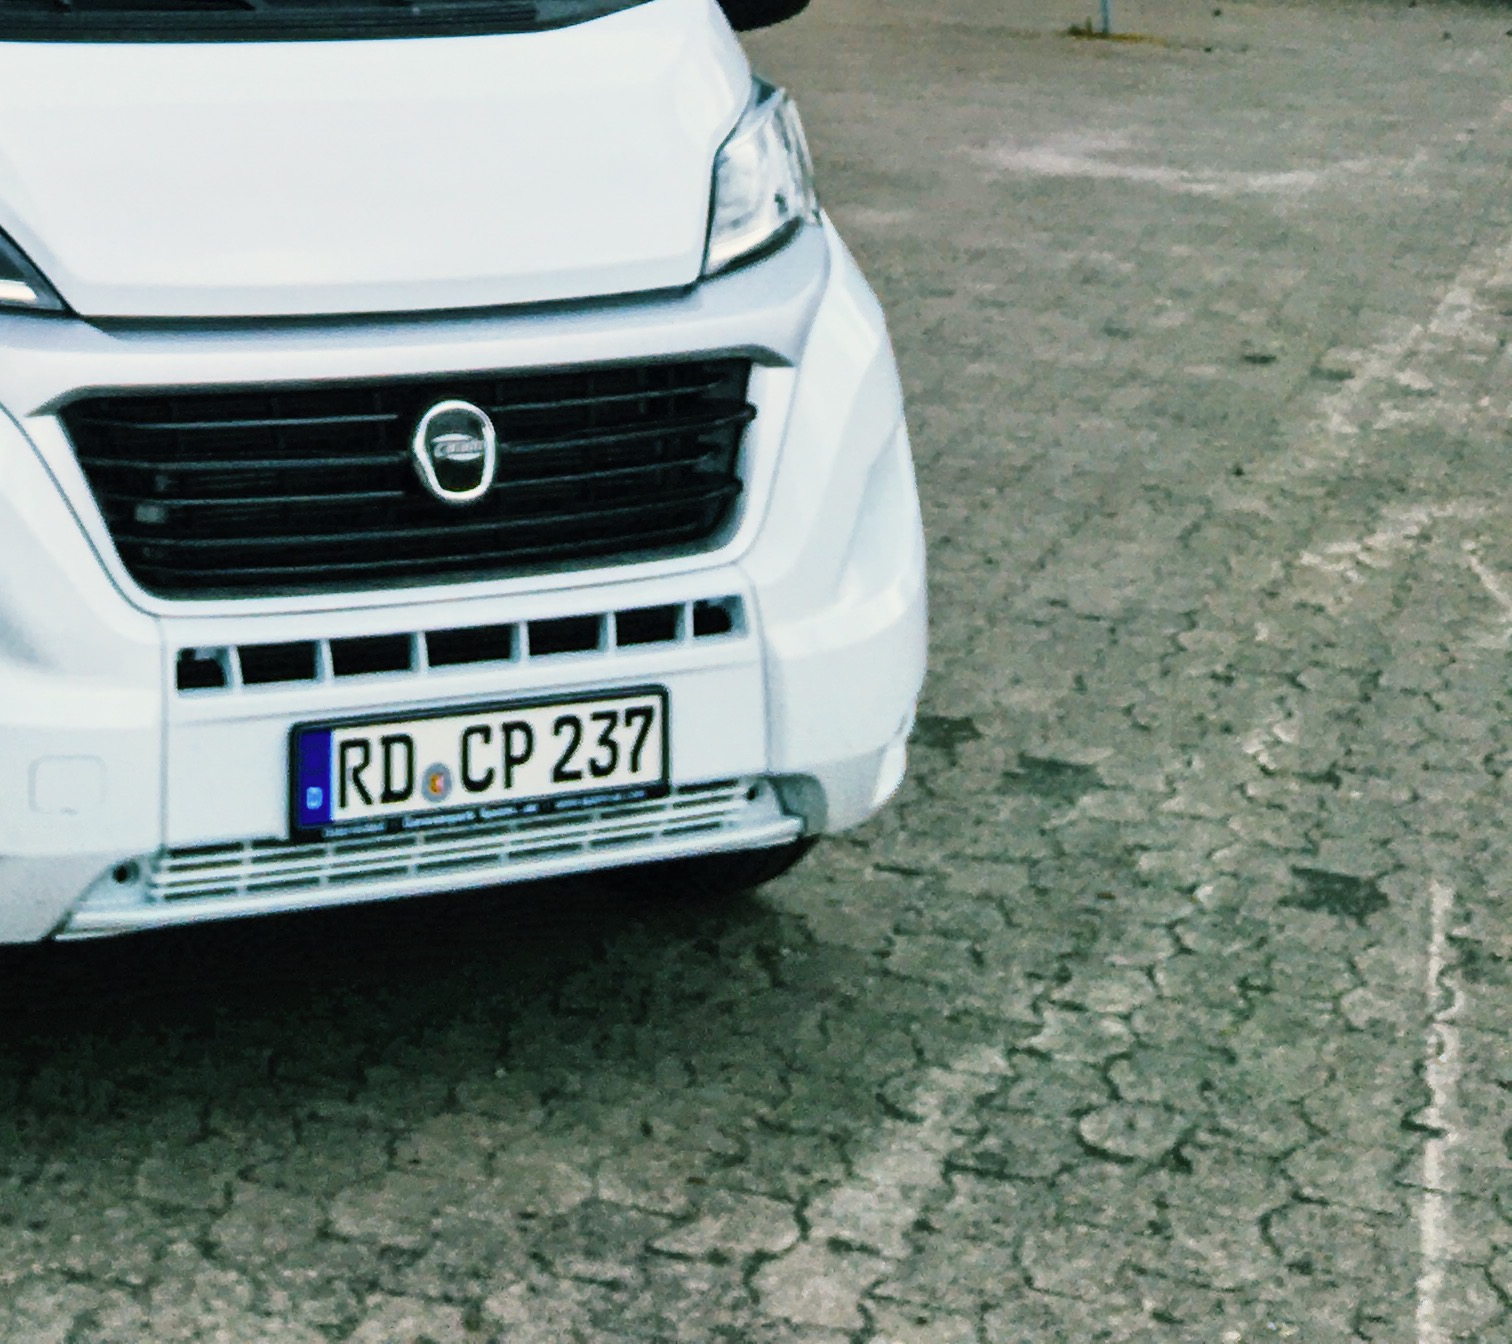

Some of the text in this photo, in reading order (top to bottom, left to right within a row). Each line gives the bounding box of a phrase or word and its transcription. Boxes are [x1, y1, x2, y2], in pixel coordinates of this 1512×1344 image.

[338, 705, 655, 808] RD CP 237
